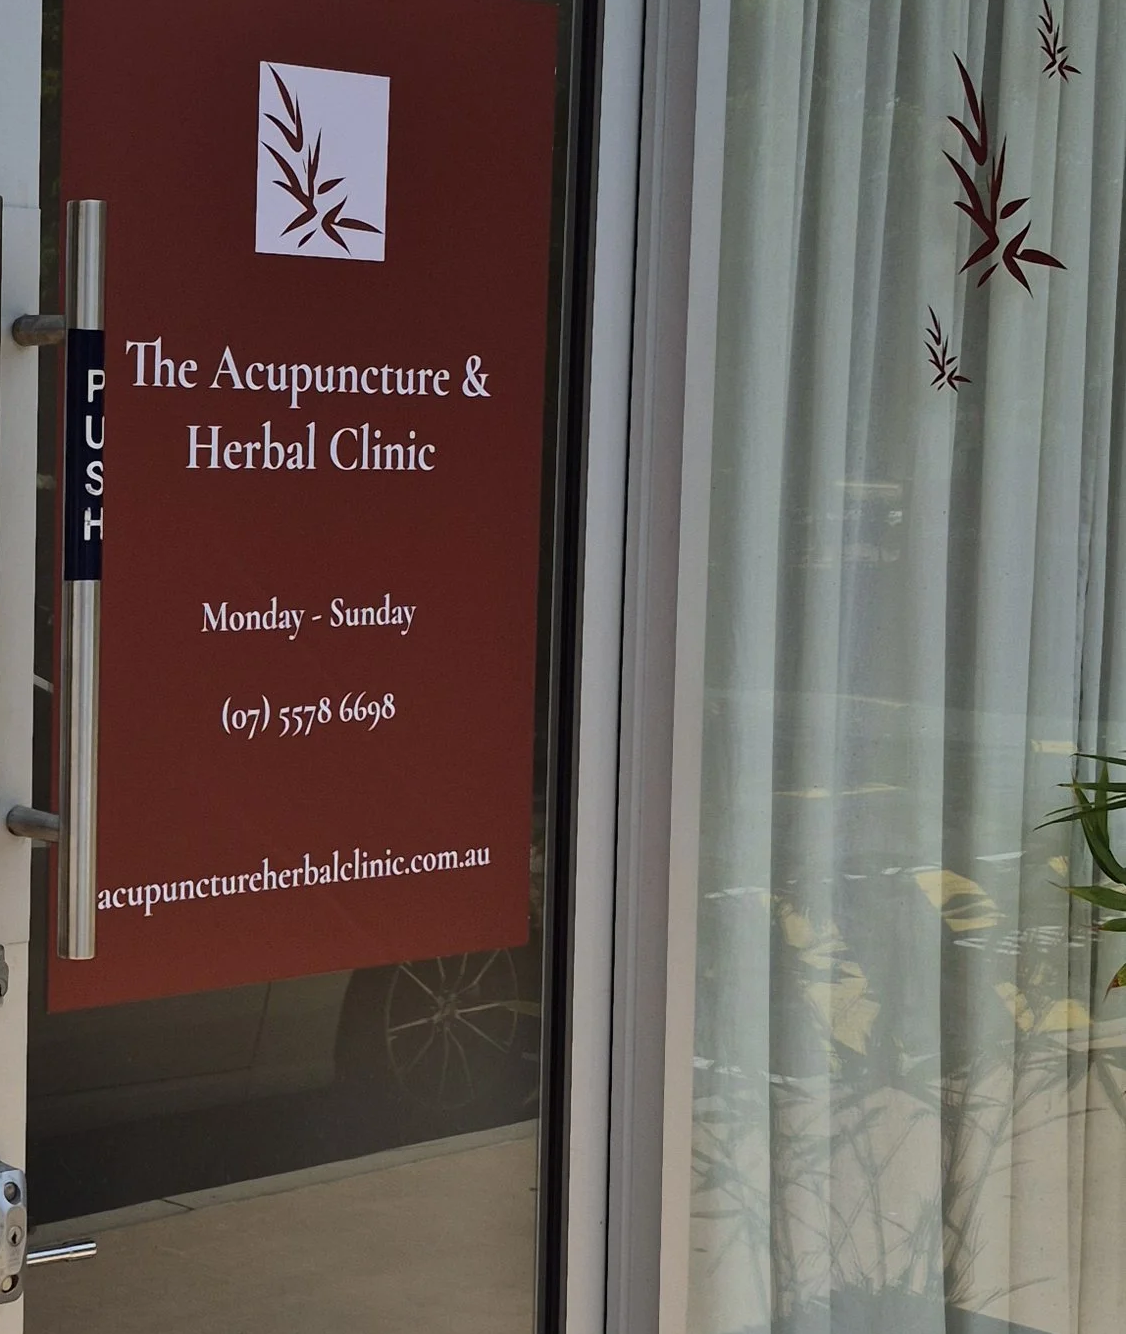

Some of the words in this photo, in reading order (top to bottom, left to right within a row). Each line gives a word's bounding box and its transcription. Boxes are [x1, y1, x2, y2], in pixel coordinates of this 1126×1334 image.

[125, 336, 199, 390] The
[209, 345, 451, 409] Acupuncture
[461, 354, 492, 398] &
[83, 368, 107, 542] PUSH
[185, 420, 317, 471] Herbal
[329, 422, 437, 472] Clinic
[201, 595, 306, 641] Monday
[330, 592, 417, 637] Sunday
[222, 694, 271, 740] (07)
[278, 695, 333, 739] 5578
[339, 690, 397, 732] 6698
[96, 846, 492, 917] acupunctureherbalclinic.com.au
